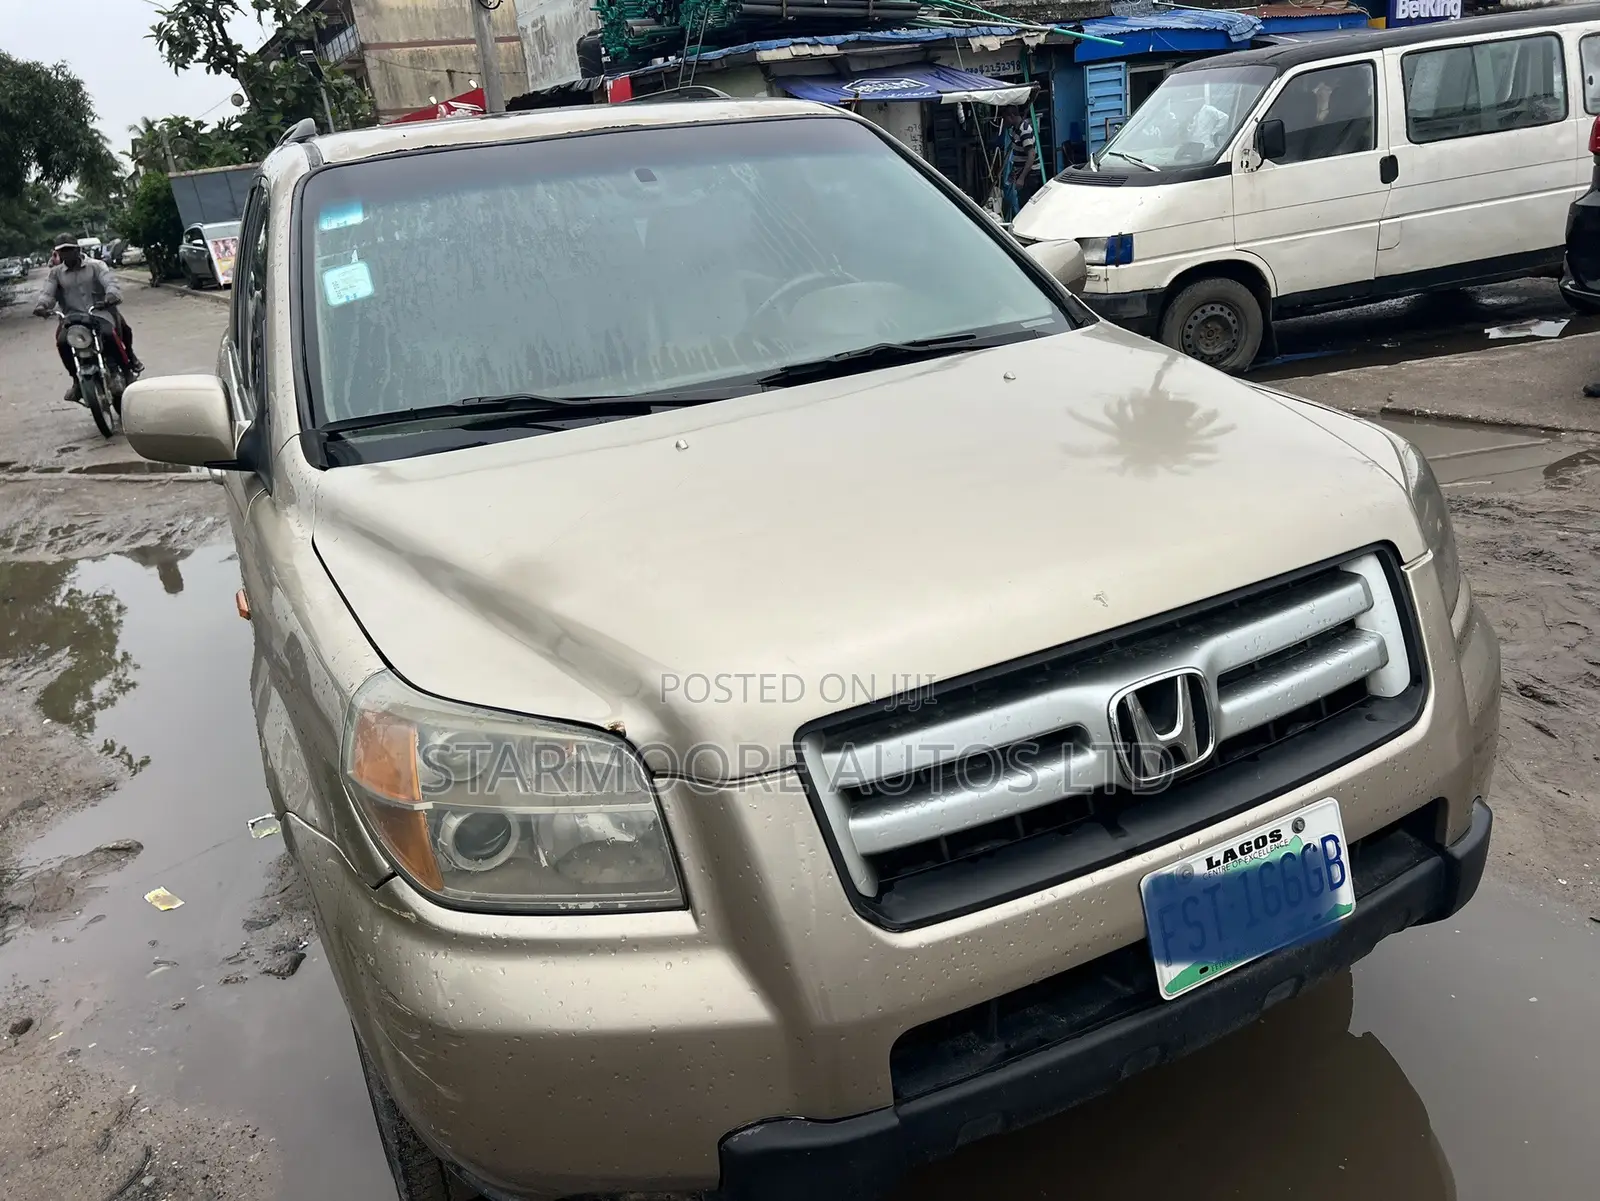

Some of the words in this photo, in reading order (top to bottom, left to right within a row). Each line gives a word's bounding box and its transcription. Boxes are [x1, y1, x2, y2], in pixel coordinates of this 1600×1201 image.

[1396, 0, 1461, 19] BetKing
[1203, 862, 1231, 880] CENTRE
[1244, 839, 1289, 863] EXCELLENCE
[1205, 829, 1282, 870] LAGOS
